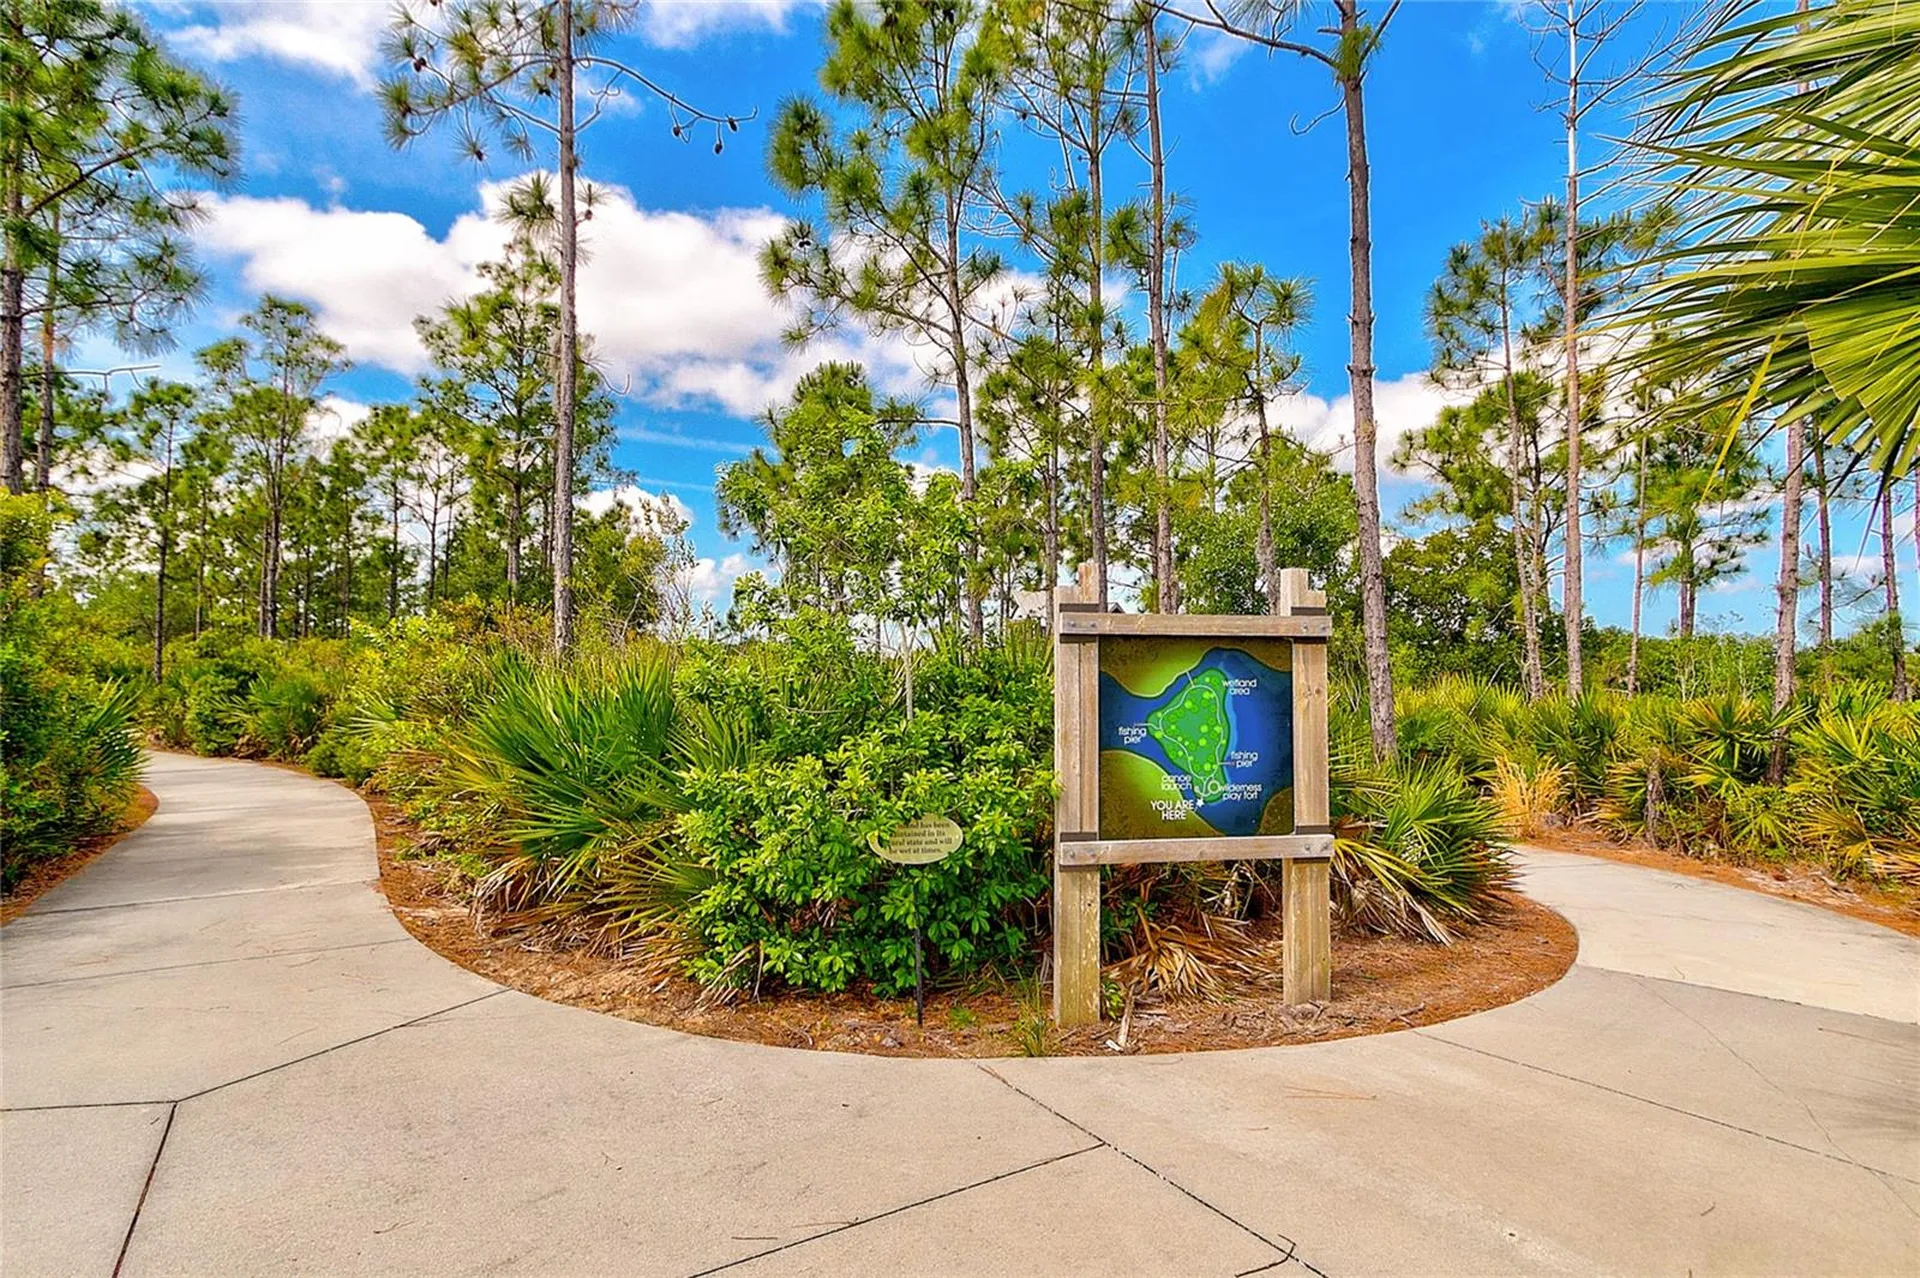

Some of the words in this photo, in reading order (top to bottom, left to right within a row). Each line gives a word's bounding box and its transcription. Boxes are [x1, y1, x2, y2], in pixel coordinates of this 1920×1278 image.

[1222, 678, 1258, 687] wetland
[1229, 687, 1250, 695] area
[1118, 726, 1147, 738] fishing
[1123, 735, 1141, 745] pier
[1230, 750, 1258, 762] fishing
[1236, 759, 1253, 768] pier
[1161, 775, 1192, 783] canoe
[1161, 781, 1193, 791] launch
[1218, 783, 1262, 792] wilderness
[1222, 791, 1241, 801] play
[1243, 790, 1258, 800] fort
[1150, 800, 1173, 811] YOU
[1174, 800, 1194, 810] ARE
[1161, 810, 1187, 820] HERE
